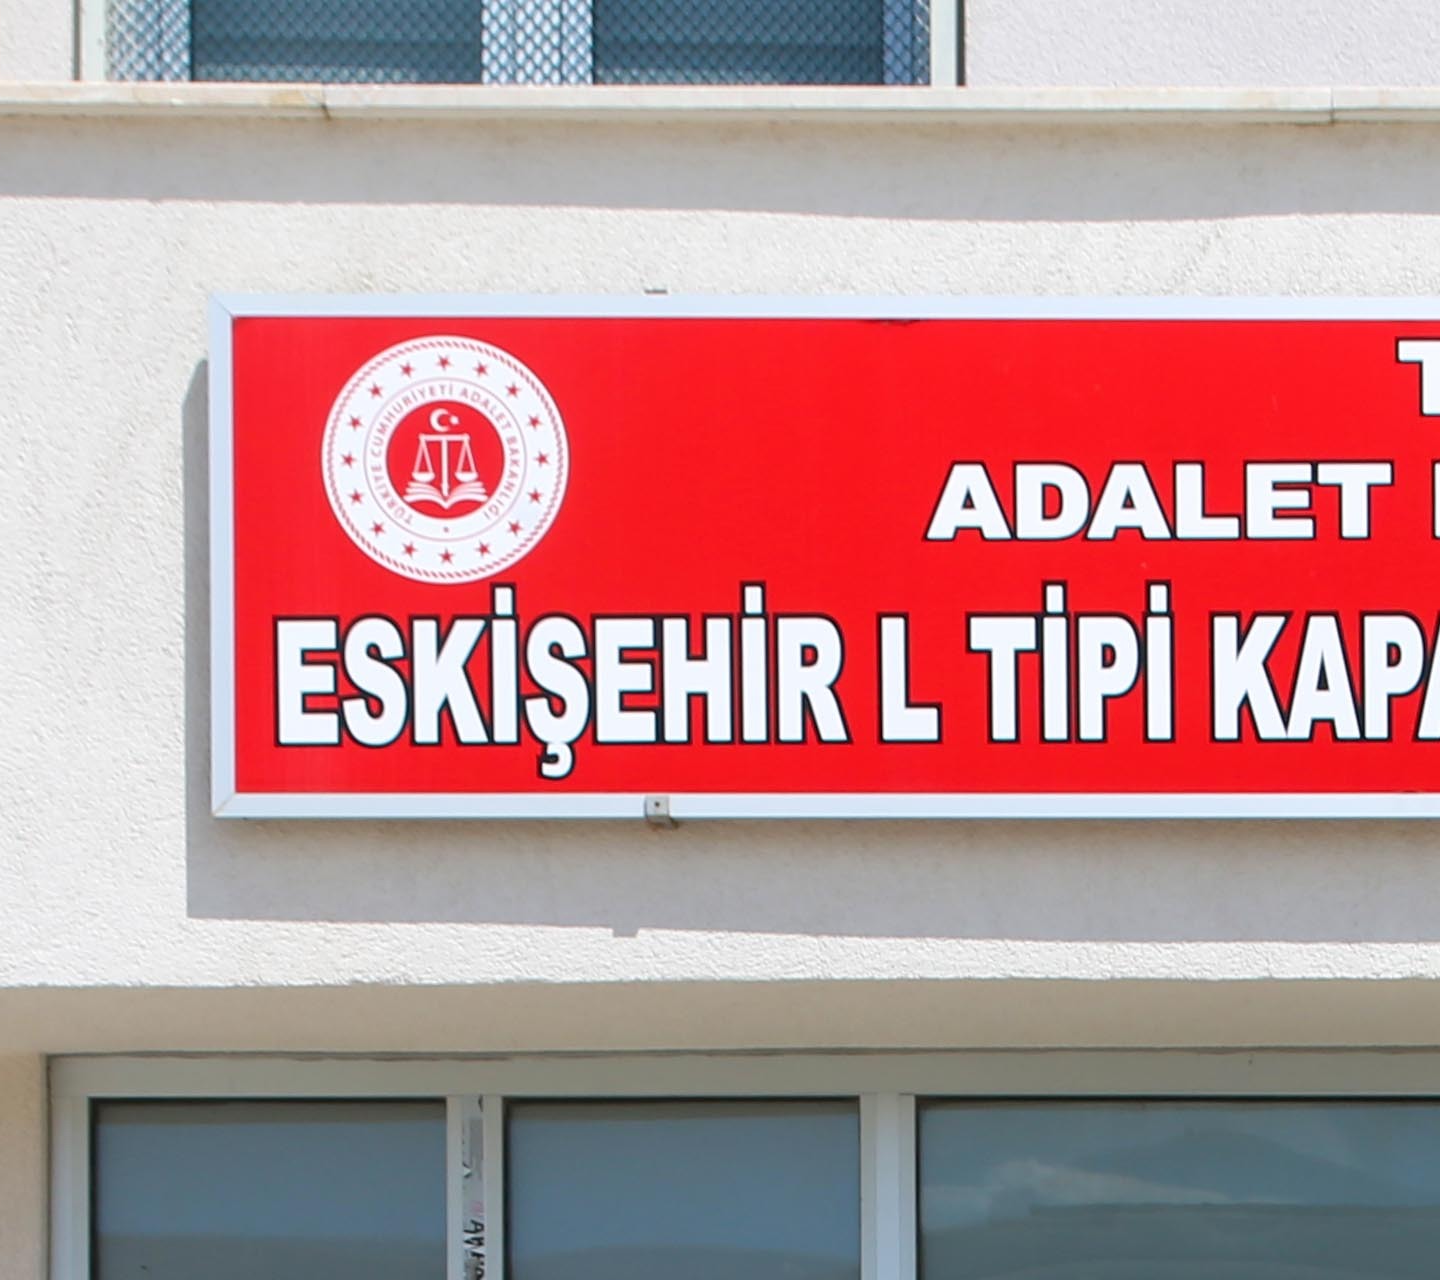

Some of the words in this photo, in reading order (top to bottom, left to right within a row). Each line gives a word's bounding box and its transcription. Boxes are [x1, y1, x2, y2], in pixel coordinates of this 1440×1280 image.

[460, 389, 511, 430] ADALET
[924, 460, 1393, 541] ADALET
[272, 581, 853, 779] ESKİŞEHİR
[877, 612, 942, 743] L
[966, 580, 1174, 743] TİPİ
